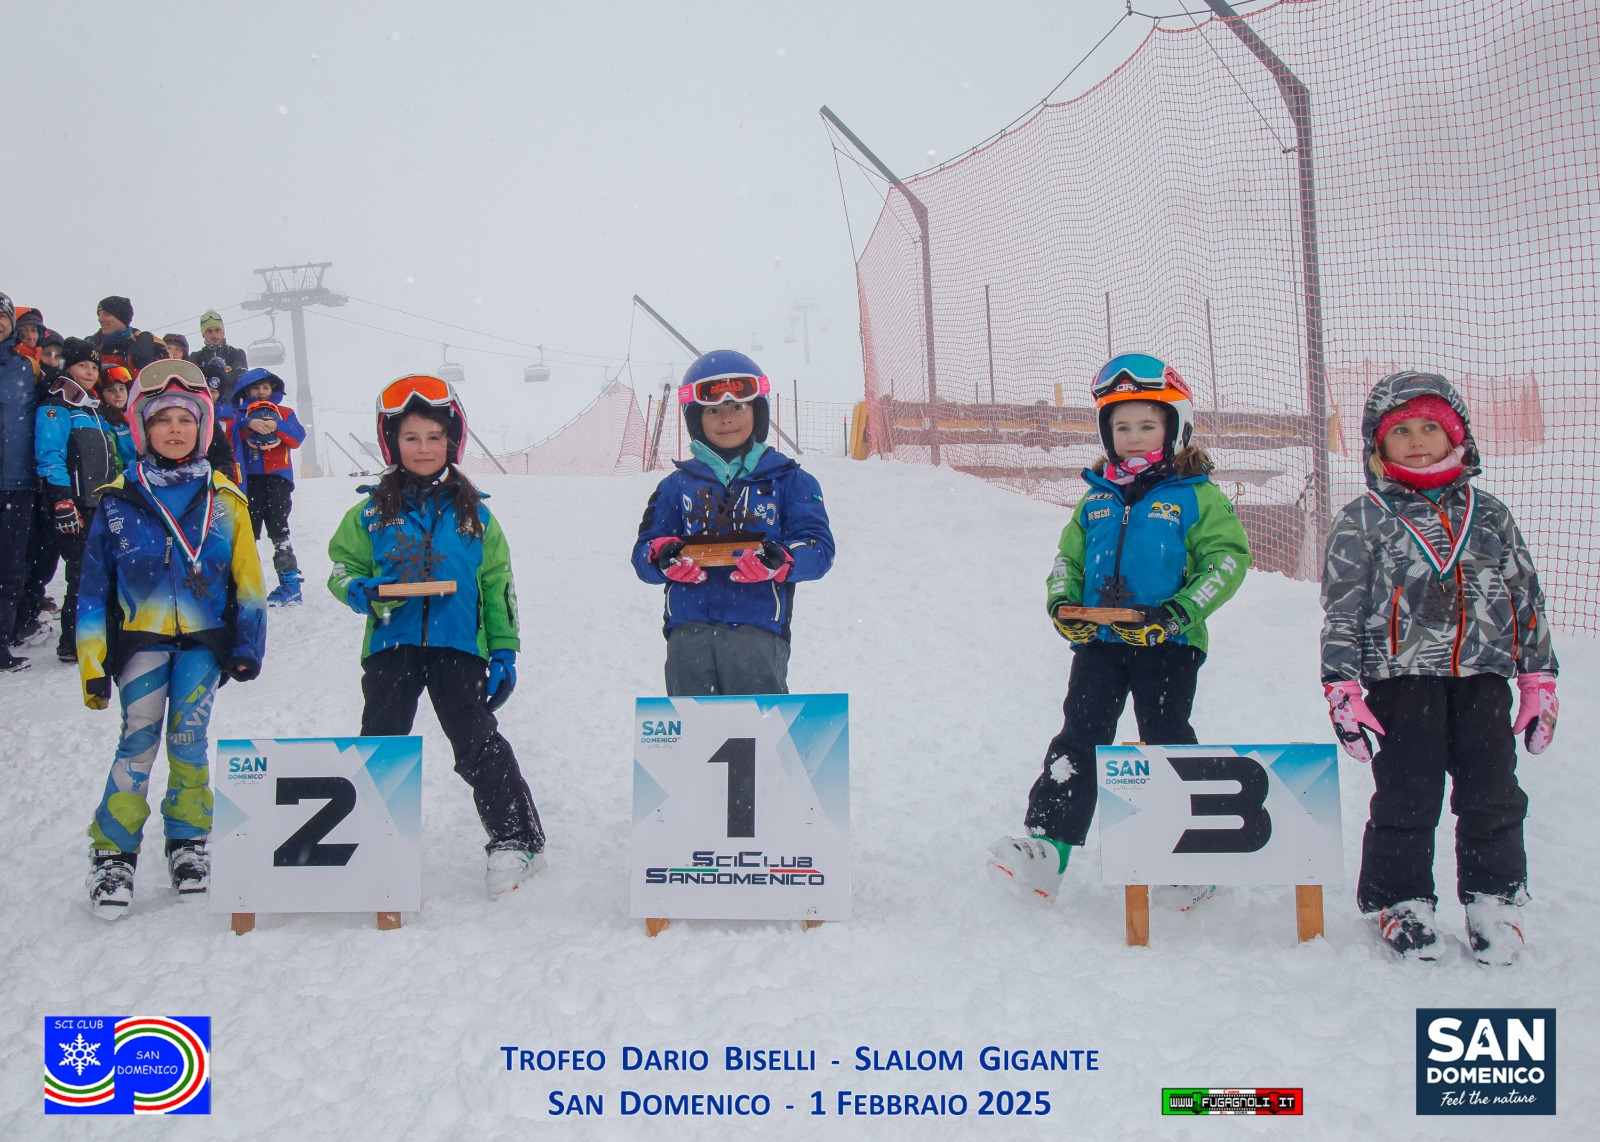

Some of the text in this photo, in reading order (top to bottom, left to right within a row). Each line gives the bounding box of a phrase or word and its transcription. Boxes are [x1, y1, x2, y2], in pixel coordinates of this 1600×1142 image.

[642, 720, 682, 736] SAN
[229, 757, 268, 773] SAN
[707, 738, 756, 838] 1
[1105, 759, 1150, 777] SAN
[273, 776, 360, 867] 2
[1166, 757, 1273, 853] 3
